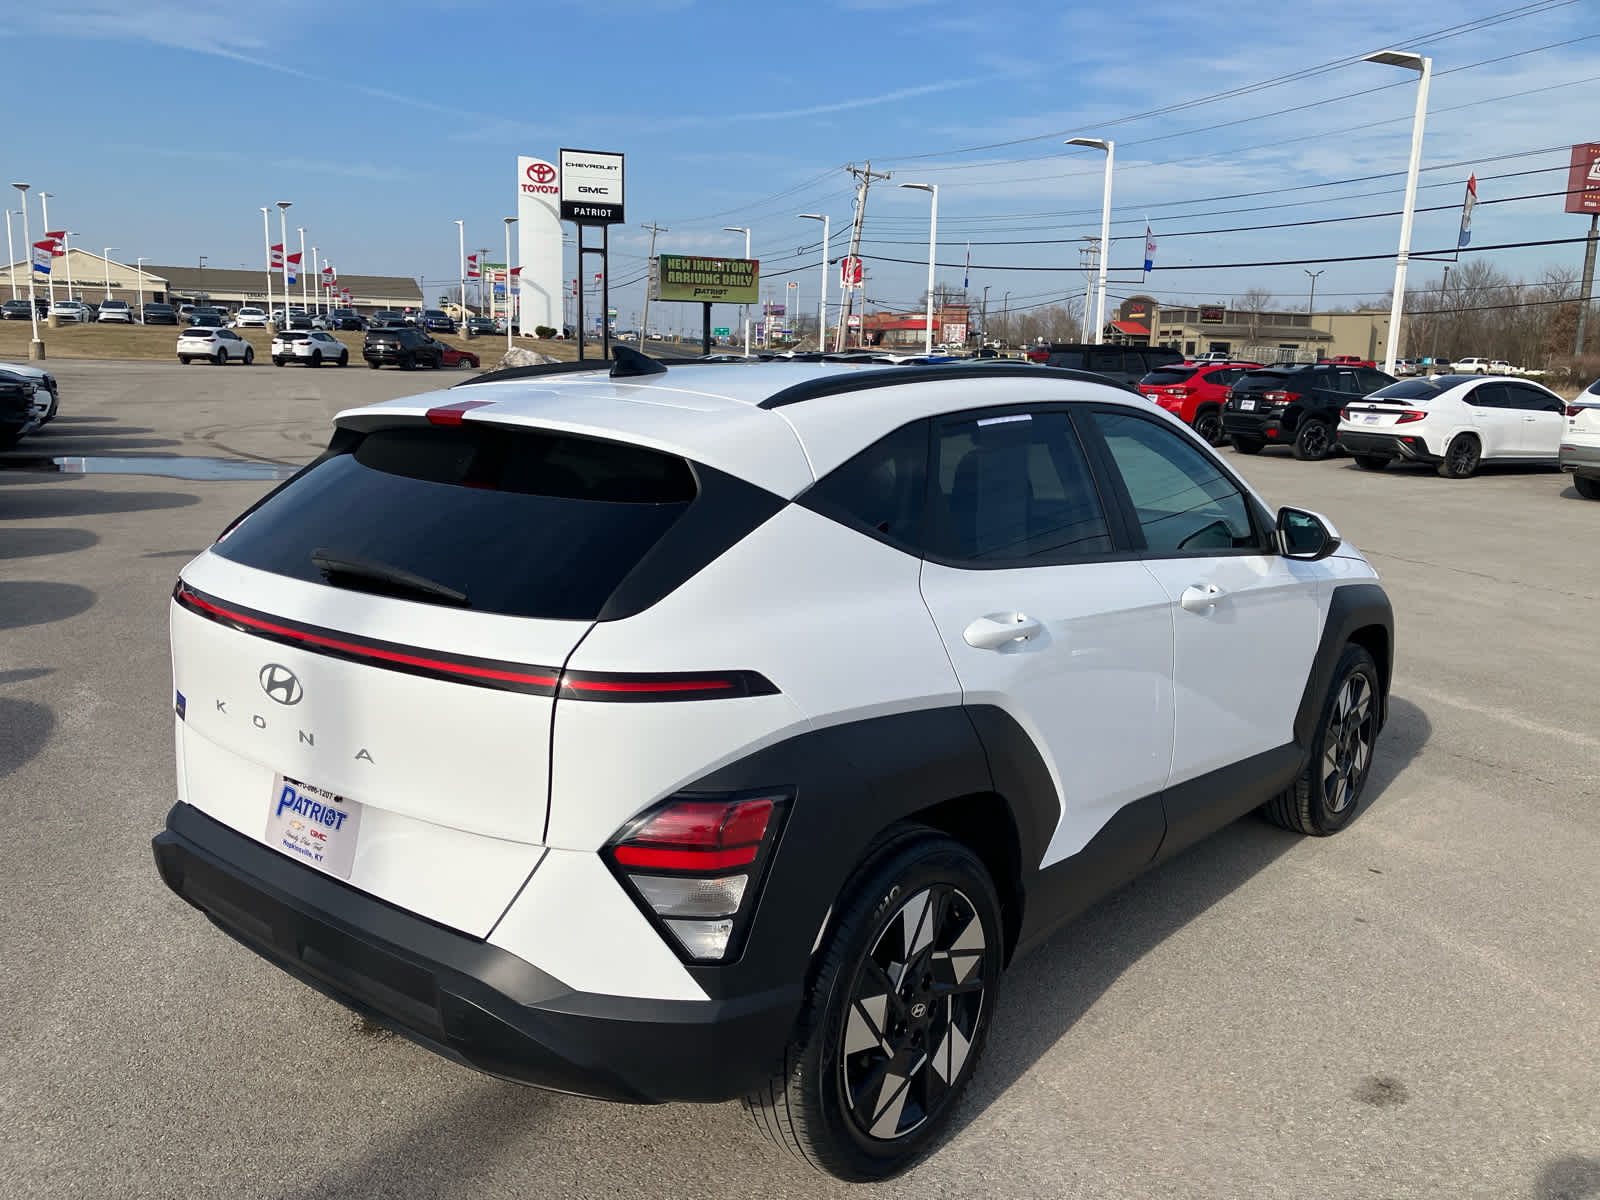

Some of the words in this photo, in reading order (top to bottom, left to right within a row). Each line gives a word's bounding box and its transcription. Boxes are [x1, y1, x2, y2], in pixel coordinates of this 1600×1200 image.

[565, 162, 618, 171] CHEVROLET
[521, 184, 559, 194] TOYOTA
[578, 186, 609, 195] GMC
[574, 207, 612, 217] PATRIOT
[692, 260, 753, 273] INVENTORY
[667, 271, 720, 285] ARRIVING
[722, 274, 753, 287] DAILY
[693, 287, 728, 297] PATRIOT
[275, 784, 349, 831] PATRIOT
[309, 829, 328, 842] GMC
